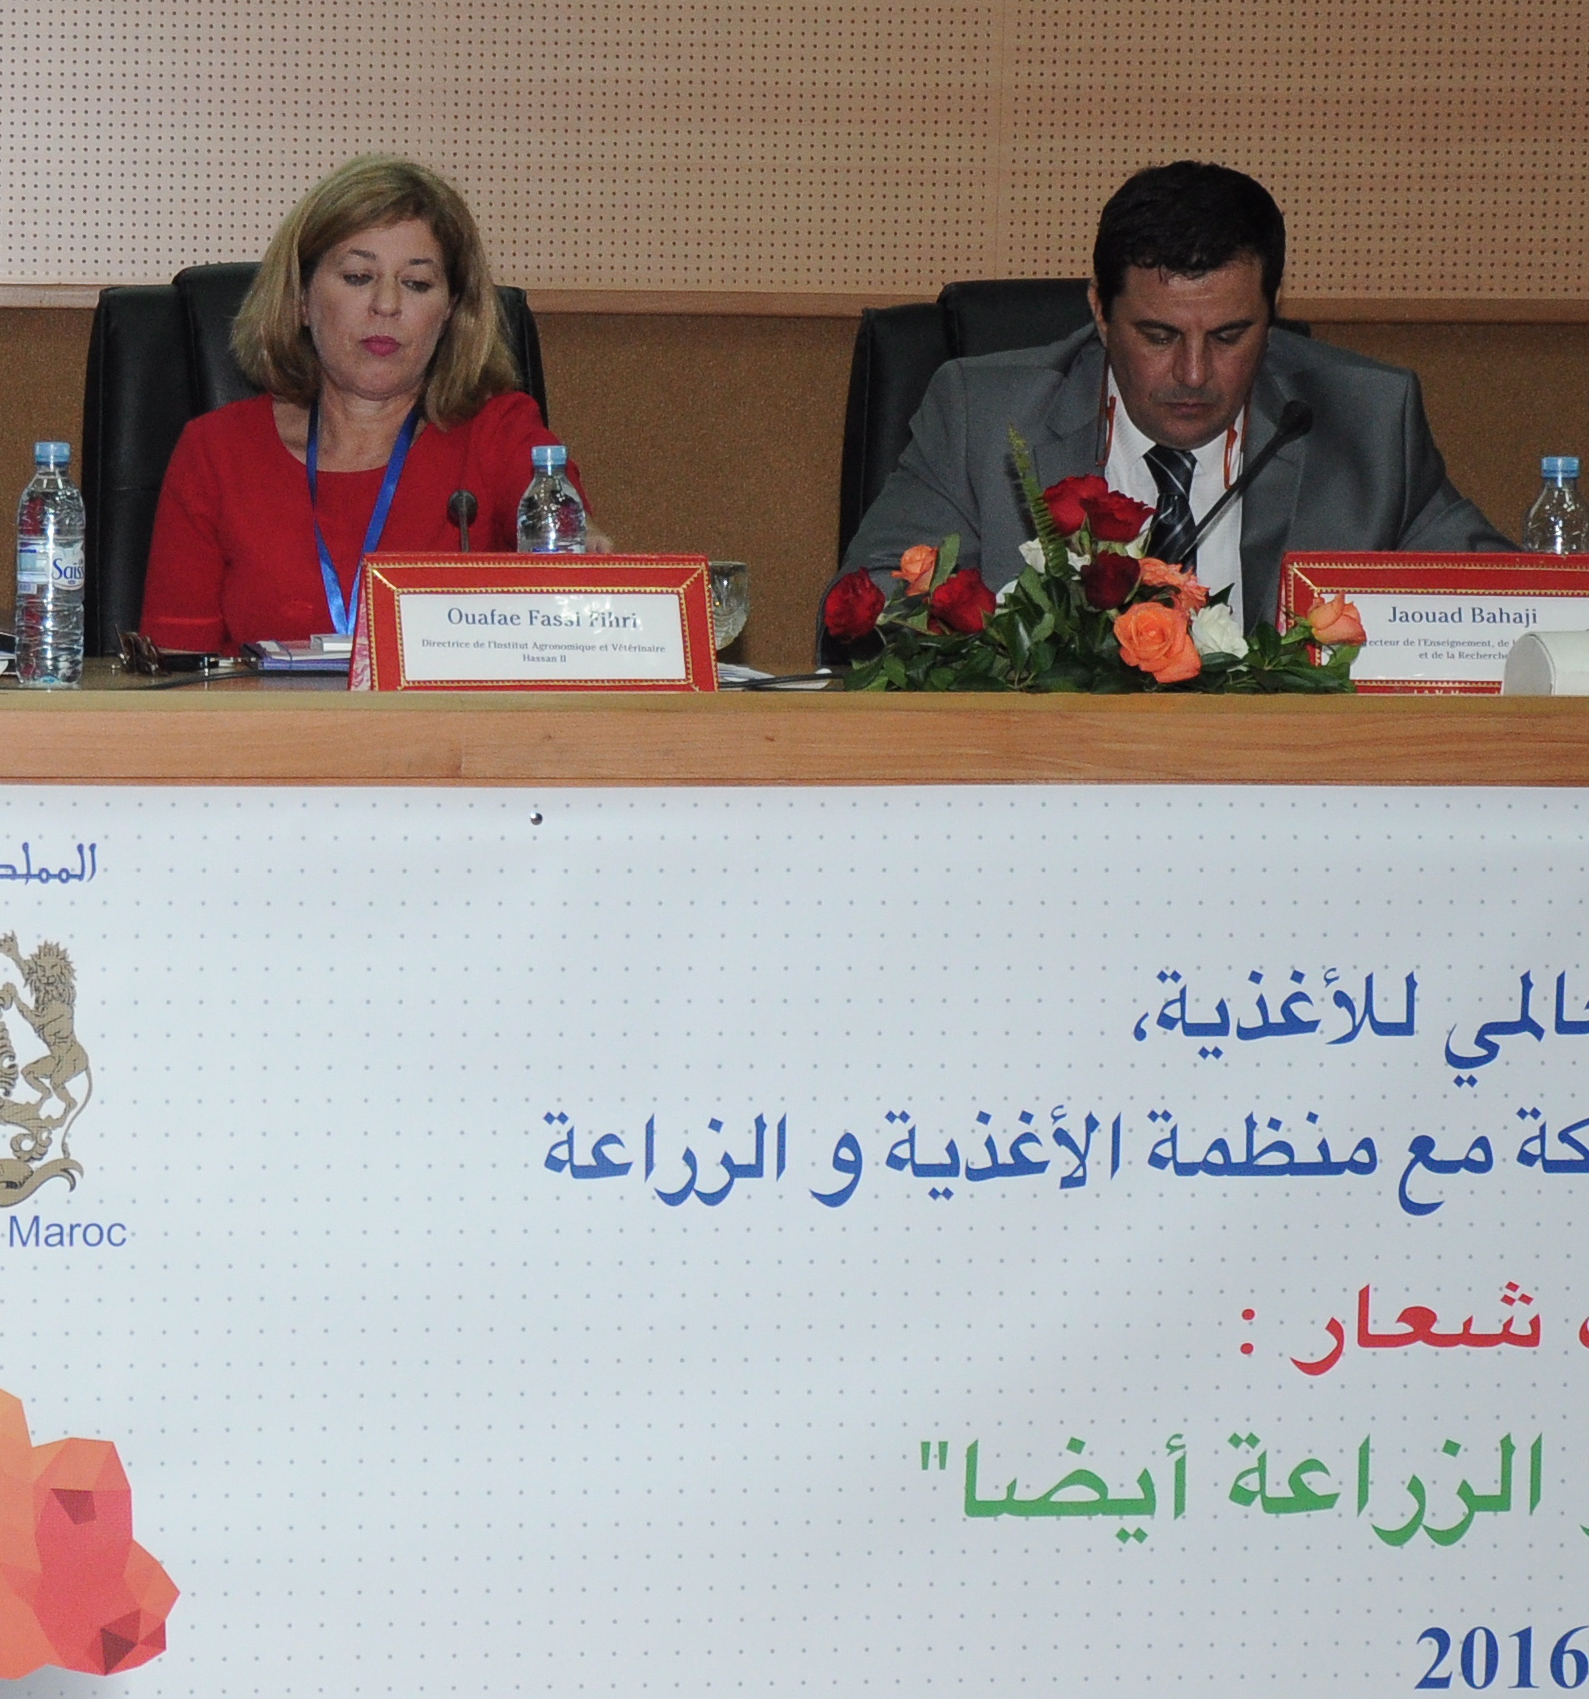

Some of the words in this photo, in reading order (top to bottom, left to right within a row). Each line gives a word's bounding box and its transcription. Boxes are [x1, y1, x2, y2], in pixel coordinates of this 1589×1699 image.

[421, 638, 471, 650] Directrice
[472, 639, 486, 650] de
[531, 641, 597, 654] Agronomique
[598, 643, 609, 652] et
[611, 642, 667, 654] Vétérinaire
[446, 607, 522, 627] Ouafae
[528, 608, 582, 628] Fassi
[1387, 605, 1463, 625] Jaouad
[1470, 605, 1538, 629] Bahaji
[1402, 637, 1416, 648] de
[1497, 638, 1510, 648] de
[522, 652, 558, 664] Hassan
[1418, 651, 1429, 660] et
[1431, 650, 1444, 660] de
[1446, 650, 1456, 660] la
[1445, 968, 1589, 1089] المي
[543, 1110, 790, 1208] الزراعة
[809, 1131, 866, 1210] و
[884, 1104, 1124, 1201] الأغذية
[1146, 1110, 1380, 1179] منظمة
[1398, 1133, 1496, 1218] مع
[8, 1215, 130, 1249] Maroc
[1290, 1280, 1542, 1376] شعار
[1227, 1431, 1544, 1547] الزراعة
[1414, 1625, 1589, 1692] 2016
